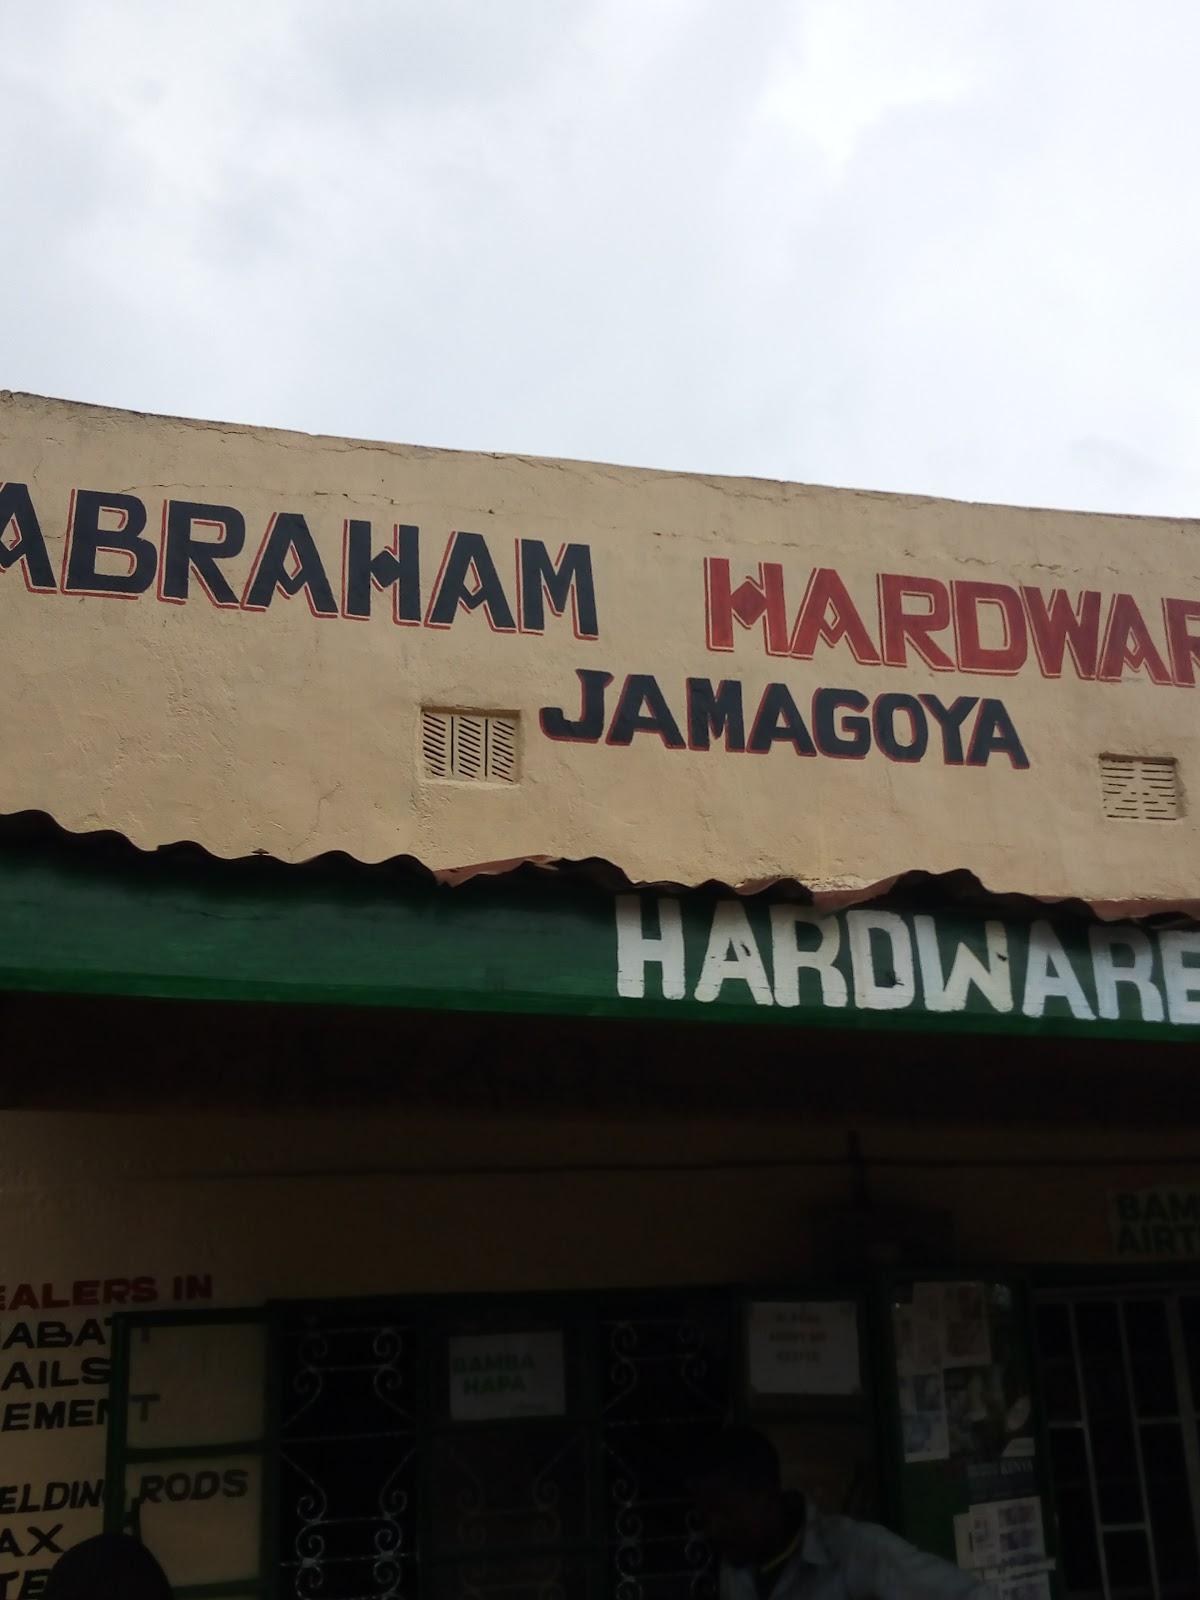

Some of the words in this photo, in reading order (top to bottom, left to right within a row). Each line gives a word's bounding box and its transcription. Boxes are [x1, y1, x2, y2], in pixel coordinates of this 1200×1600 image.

[540, 669, 1030, 769] JAMAGOYA
[615, 894, 1200, 1026] HARDWARE
[0, 1276, 158, 1311] ALERS
[173, 1274, 213, 1300] IN
[139, 1469, 249, 1503] RODS
